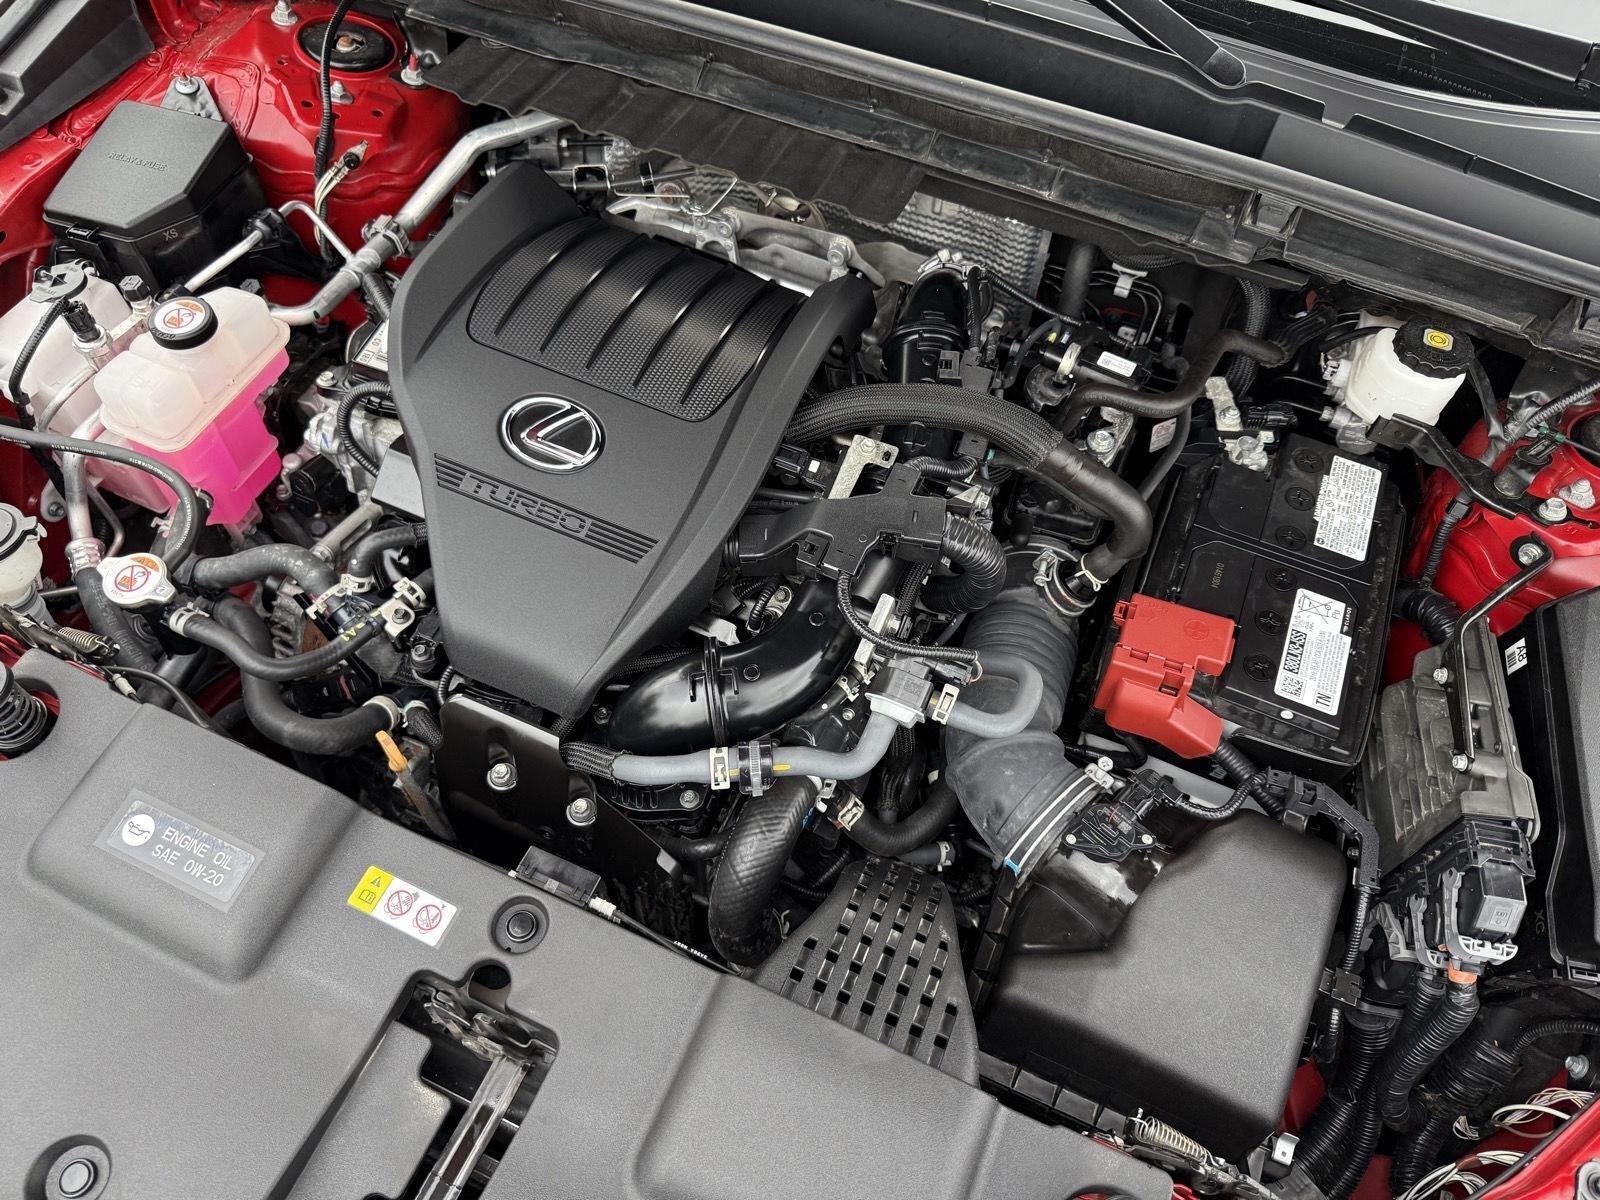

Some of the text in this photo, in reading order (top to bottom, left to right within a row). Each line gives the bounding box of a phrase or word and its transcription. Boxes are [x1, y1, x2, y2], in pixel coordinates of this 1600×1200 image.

[162, 228, 179, 241] XS
[467, 473, 587, 534] TURBO
[1516, 645, 1527, 662] A8
[1315, 692, 1332, 707] TN
[161, 827, 232, 871] ENGINE OIL
[151, 844, 225, 887] SAE 0W-20
